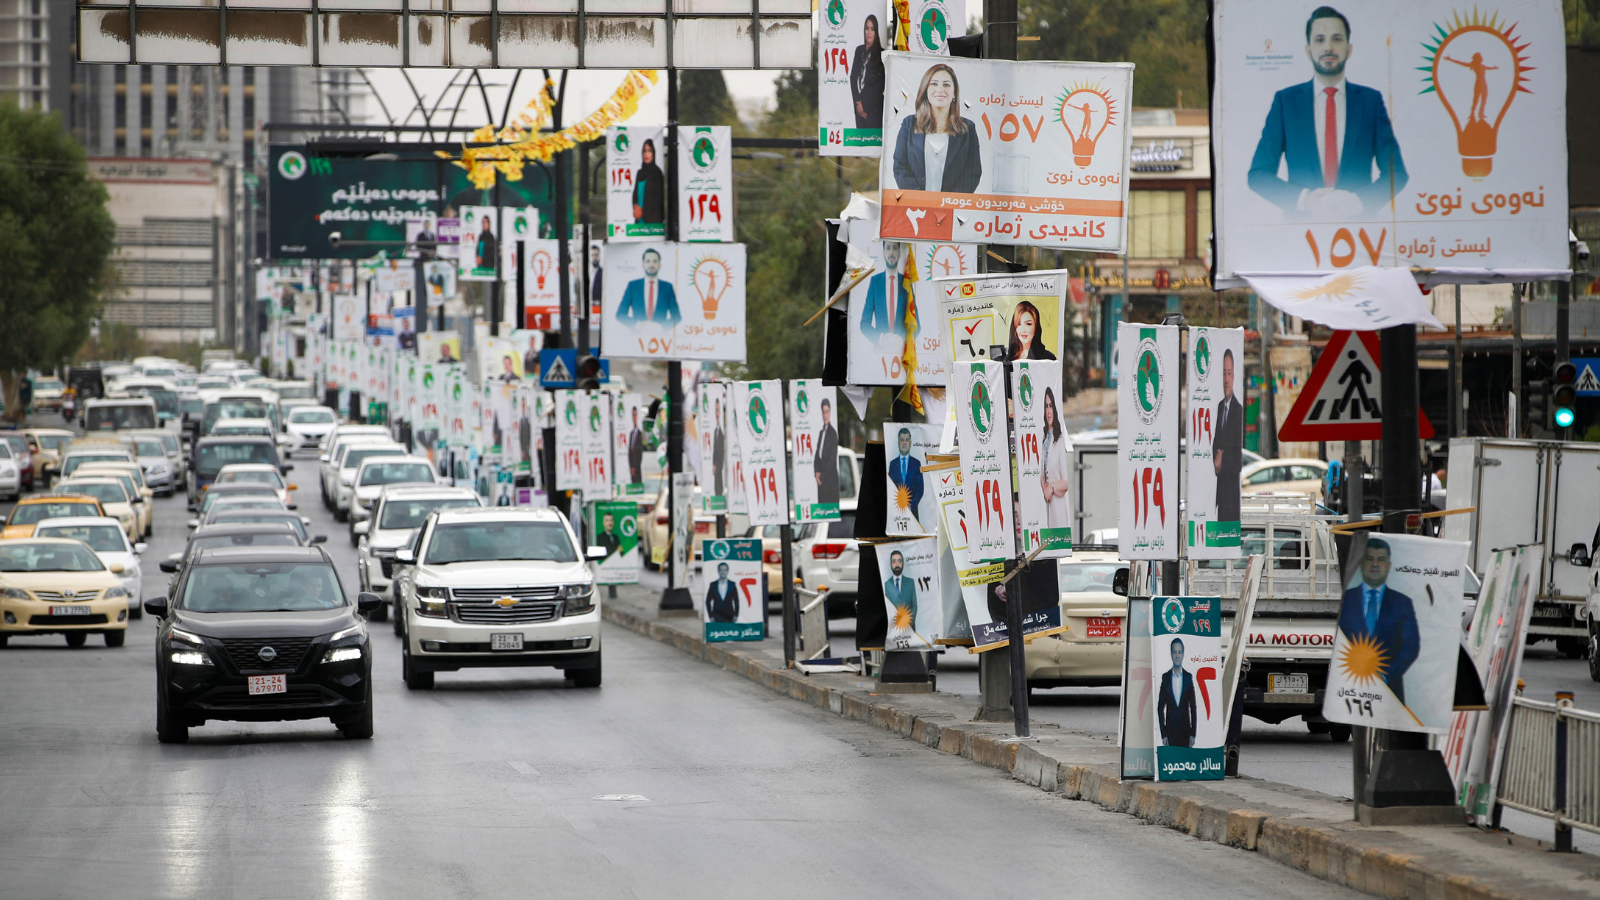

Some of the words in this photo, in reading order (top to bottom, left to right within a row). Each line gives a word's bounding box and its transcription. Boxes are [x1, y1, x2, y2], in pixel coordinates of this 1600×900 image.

[824, 47, 849, 76] ١٢٩
[979, 94, 1005, 107] ژمارە
[1009, 96, 1044, 107] لیستی
[829, 130, 842, 145] ٥٤
[981, 112, 1044, 144] ١٥٧
[611, 168, 632, 187] ١٢٩
[1046, 170, 1074, 186] نوێ
[1077, 173, 1120, 187] نەوەی
[689, 193, 722, 224] ١٢٩
[940, 196, 973, 208] عومەر
[1416, 187, 1463, 216] نوێ
[1471, 186, 1545, 215] نەوەی
[905, 207, 927, 237] ٣
[973, 214, 1023, 240] ژمارە
[1029, 219, 1106, 242] کاندیدی
[1305, 227, 1387, 268] ١٥٧
[1398, 239, 1436, 258] ژمارە
[1441, 237, 1491, 258] لیستی
[638, 337, 672, 354] ١٥٧
[960, 339, 986, 358] ٦٠
[882, 355, 901, 380] ١٥
[1193, 407, 1212, 446] ١٢٩
[796, 433, 813, 457] ١٢٩
[1021, 433, 1040, 466] ١٢٩
[753, 467, 779, 507] ١٢٩
[975, 479, 1004, 533] ١٢٩
[1132, 467, 1166, 531] ١٢٩
[1423, 566, 1440, 577] شێخ
[739, 577, 757, 609] ٢
[917, 575, 932, 593] ١٣
[1425, 583, 1435, 607] ١
[1189, 600, 1211, 613] لیستی
[1193, 619, 1212, 633] ١٢٩
[1271, 633, 1334, 646] MOTOR
[255, 675, 282, 686] 21-24
[255, 684, 283, 694] 67970
[1195, 666, 1217, 722] ٢
[1345, 697, 1374, 719] ١٦٩
[1162, 761, 1197, 776] مەحمود
[1199, 757, 1221, 776] سالار
